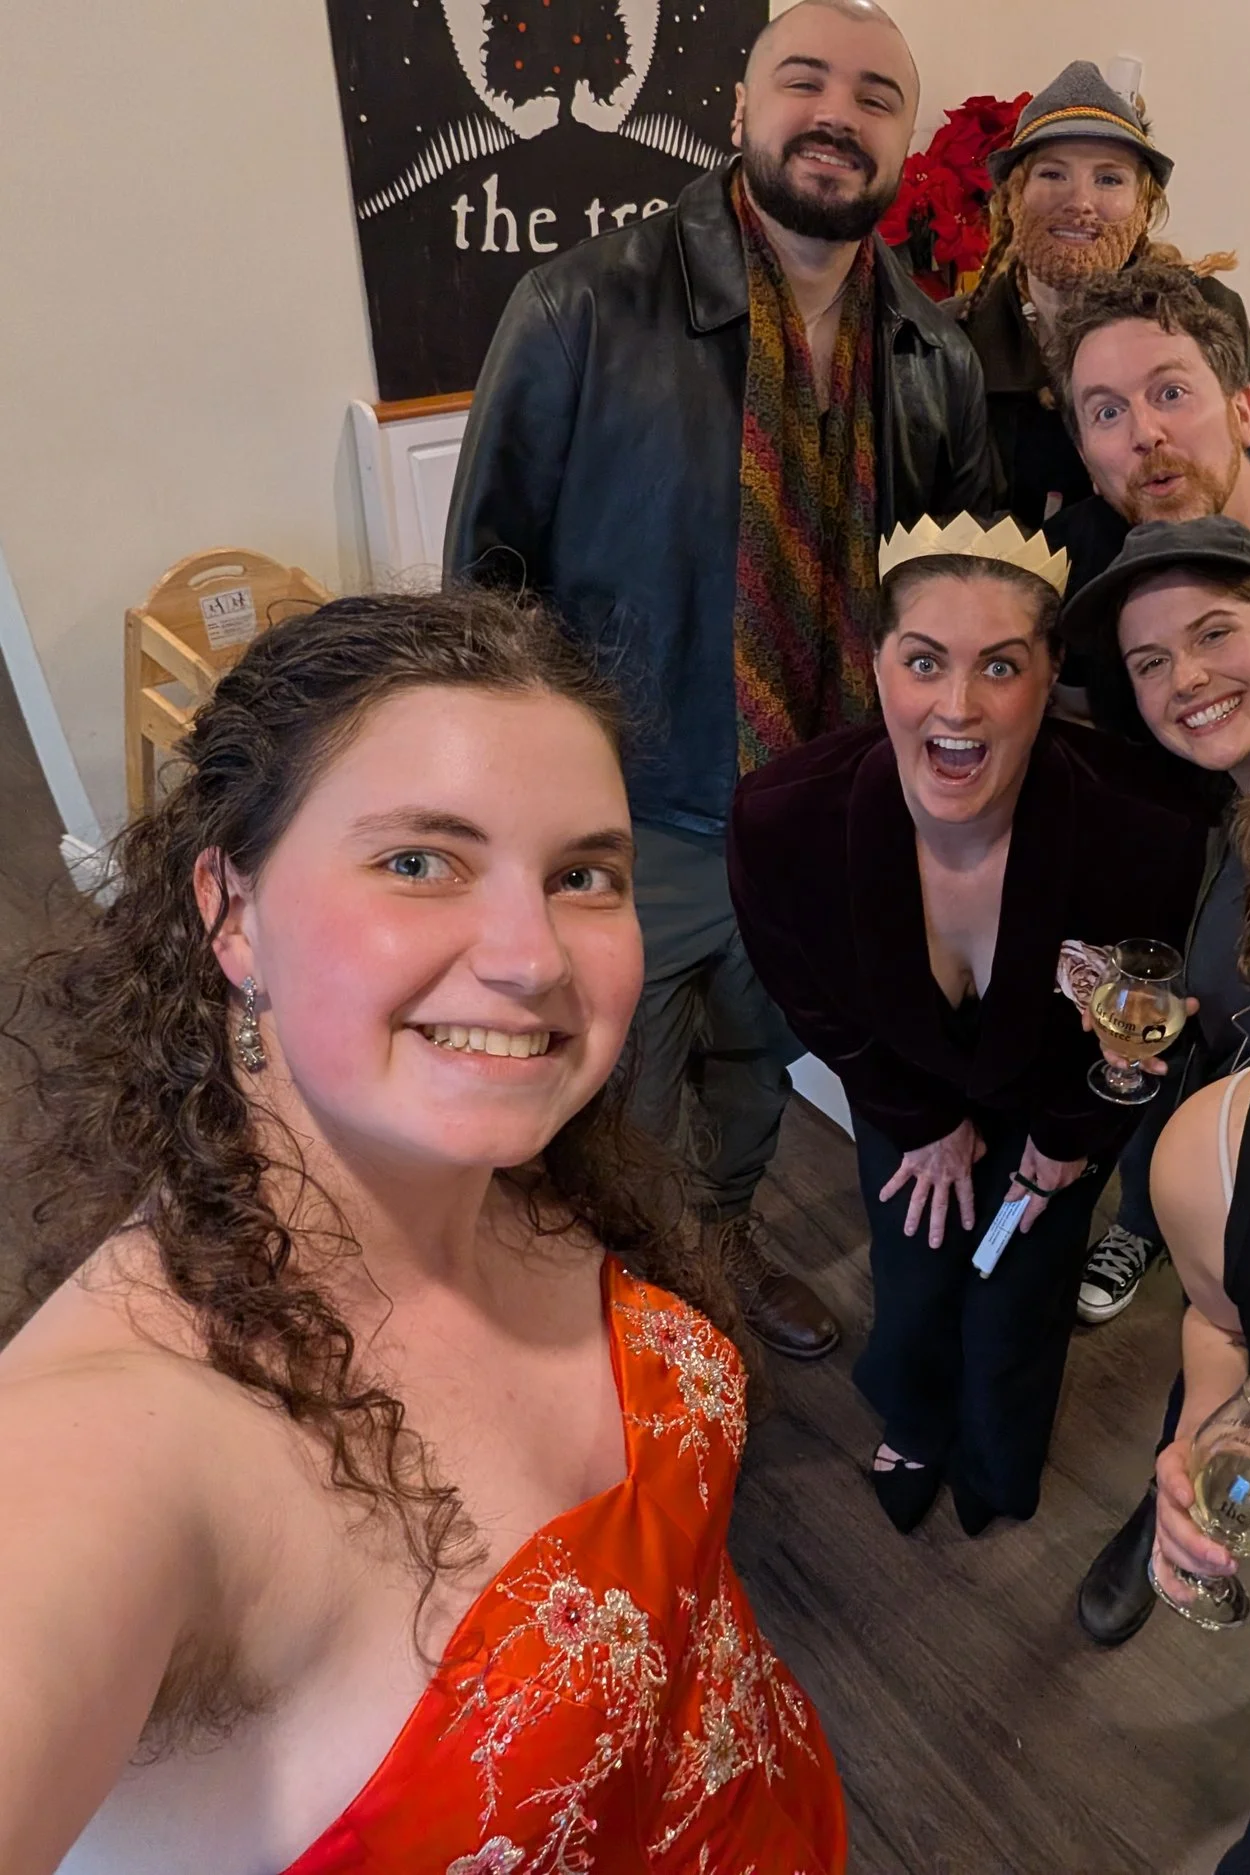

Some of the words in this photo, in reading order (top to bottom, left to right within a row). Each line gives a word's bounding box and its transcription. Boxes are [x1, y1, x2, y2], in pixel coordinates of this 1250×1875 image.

[451, 173, 559, 253] the
[1109, 1012, 1136, 1031] from
[1109, 1030, 1131, 1042] tree
[1220, 1500, 1246, 1524] the
